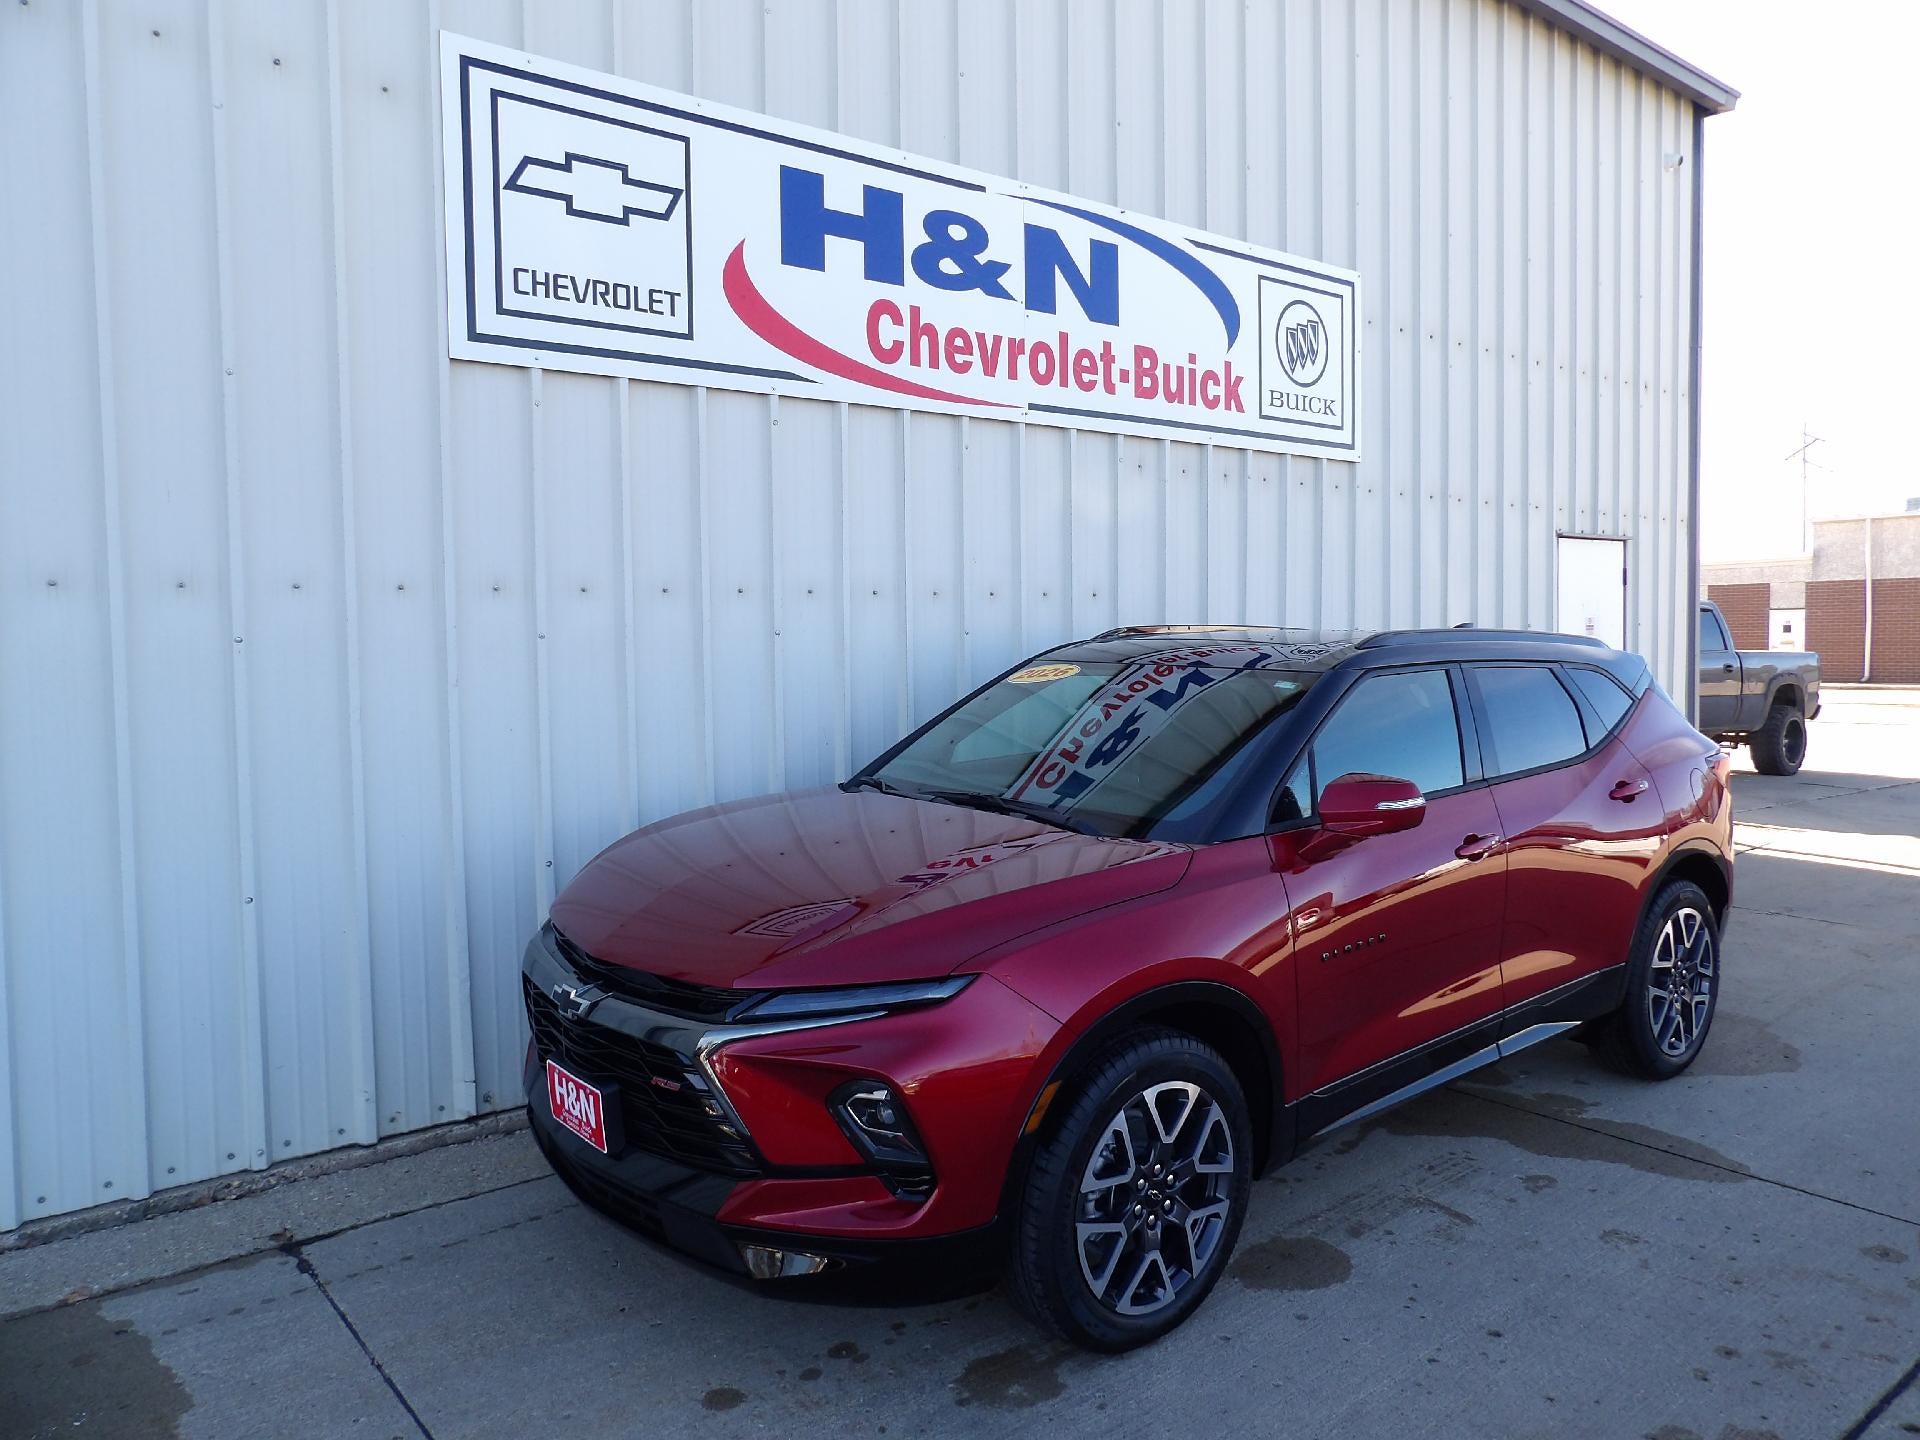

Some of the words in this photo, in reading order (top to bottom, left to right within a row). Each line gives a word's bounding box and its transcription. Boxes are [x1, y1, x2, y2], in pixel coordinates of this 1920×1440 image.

[781, 165, 1120, 326] H&N
[513, 267, 682, 318] CHEVROLET
[866, 299, 1245, 414] Chevrolet-Buick
[1268, 389, 1337, 417] BUICK
[553, 1071, 597, 1129] H&N
